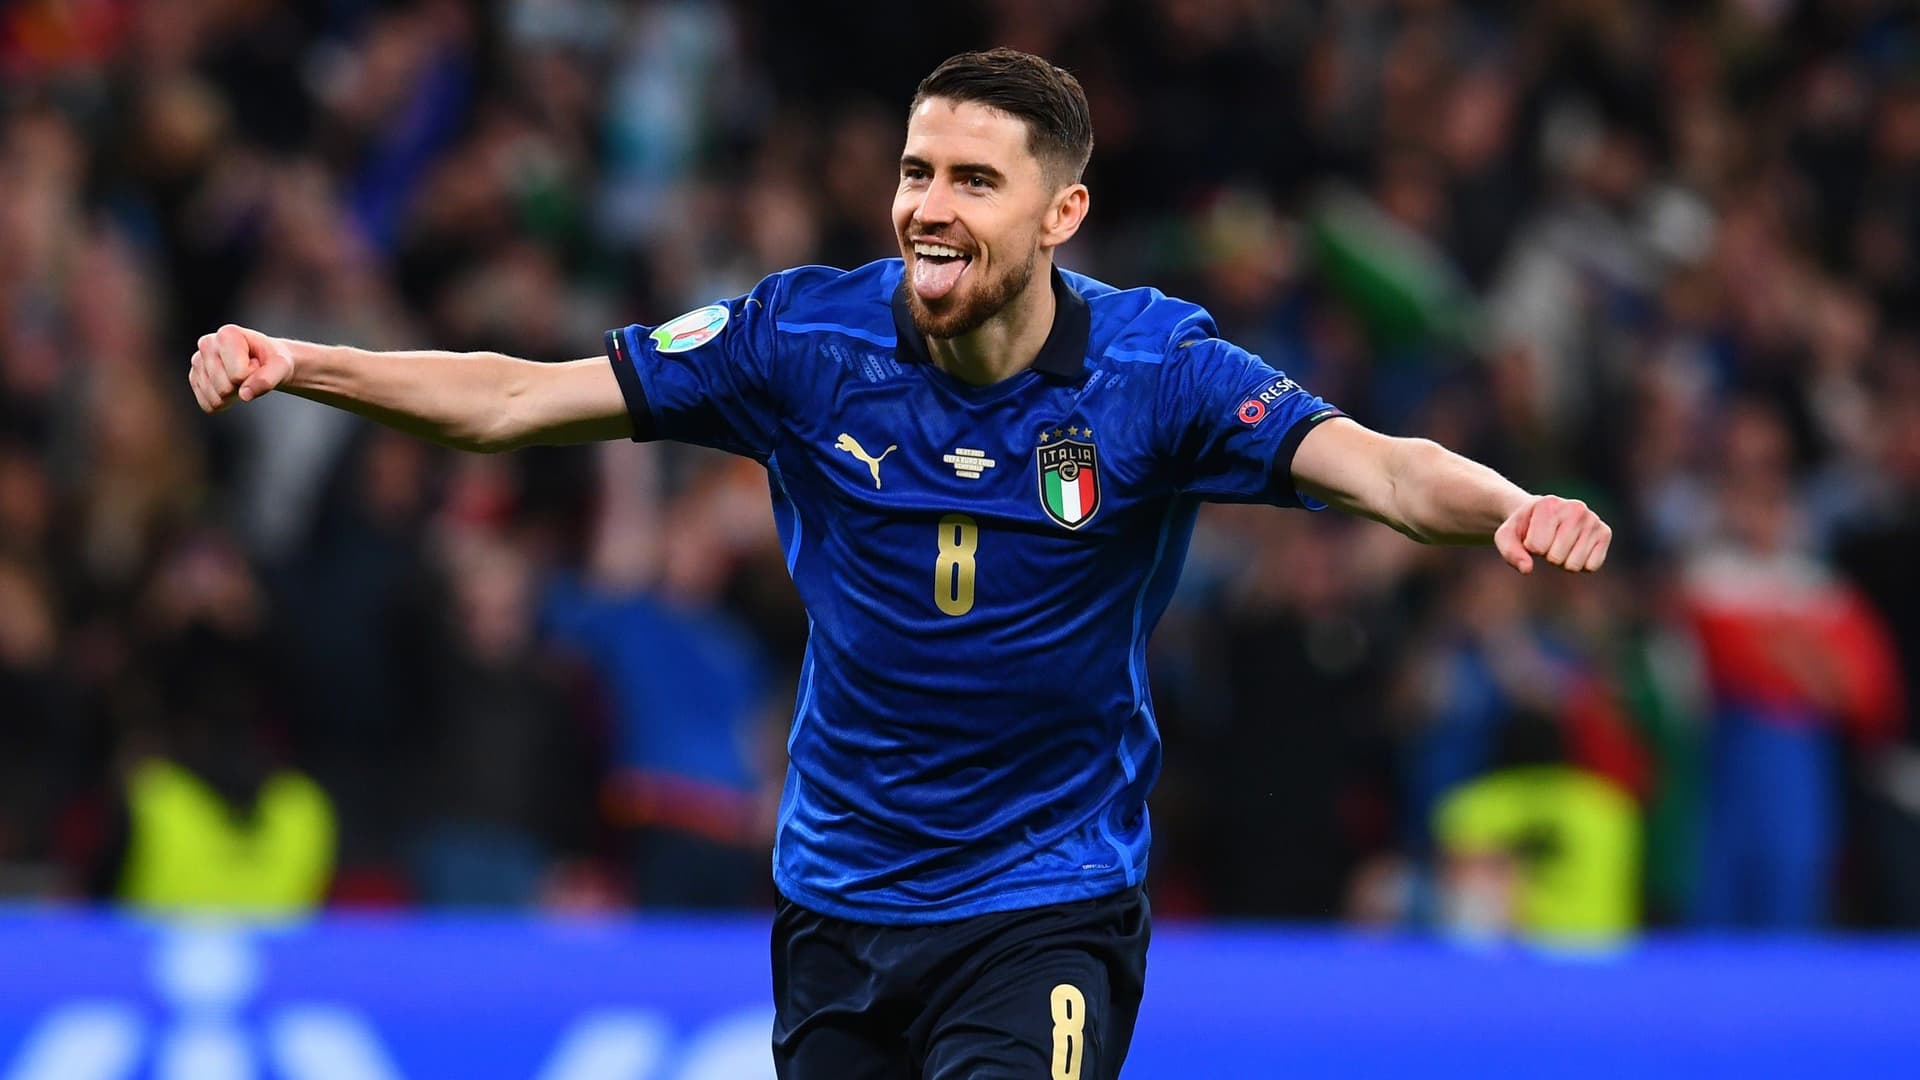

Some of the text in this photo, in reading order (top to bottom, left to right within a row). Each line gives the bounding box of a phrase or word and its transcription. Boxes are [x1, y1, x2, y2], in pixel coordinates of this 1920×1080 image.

[1260, 378, 1302, 403] RESP
[1043, 448, 1091, 464] ITALIA
[935, 514, 978, 617] 8
[1051, 984, 1086, 1080] 8
